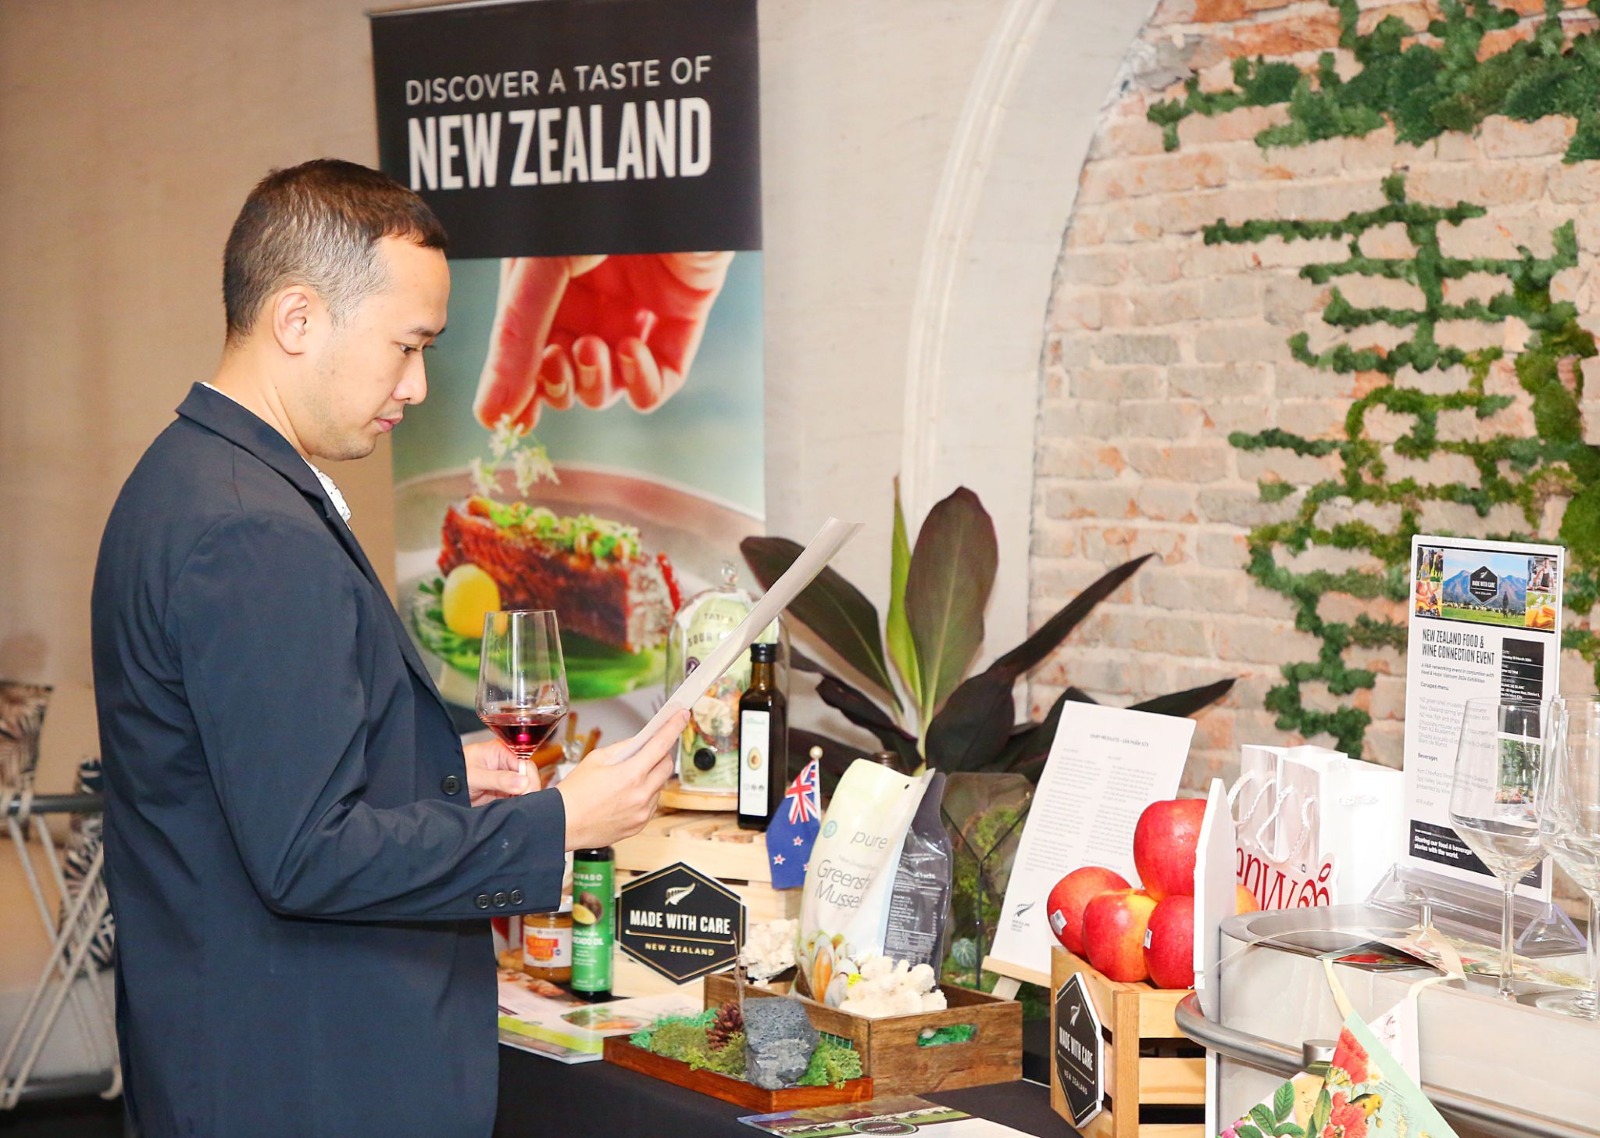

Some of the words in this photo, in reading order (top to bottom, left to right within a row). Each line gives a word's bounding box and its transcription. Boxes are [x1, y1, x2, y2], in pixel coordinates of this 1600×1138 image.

[406, 71, 539, 106] DISCOVER
[548, 68, 566, 93] A
[574, 59, 660, 91] TASTE
[670, 54, 712, 85] OF
[408, 111, 501, 191] NEW
[509, 97, 711, 186] ZEALAND
[688, 632, 713, 647] SOUR
[1423, 629, 1435, 642] NEW
[1436, 631, 1461, 645] ZEALAND
[1463, 634, 1478, 647] FOOD
[1480, 636, 1484, 648] &
[1422, 643, 1437, 657] WINE
[1438, 646, 1475, 662] CONNECTION
[1476, 651, 1495, 665] EVENT
[850, 831, 888, 850] pure
[629, 910, 663, 928] MADE
[666, 913, 697, 931] WITH
[700, 916, 731, 935] CARE
[645, 942, 666, 953] NEW
[670, 944, 715, 957] ZEALAND
[1059, 1026, 1070, 1052] MADE
[1071, 1036, 1082, 1061] WITH
[1082, 1045, 1093, 1071] CARE
[1072, 1075, 1088, 1095] ZEALAND
